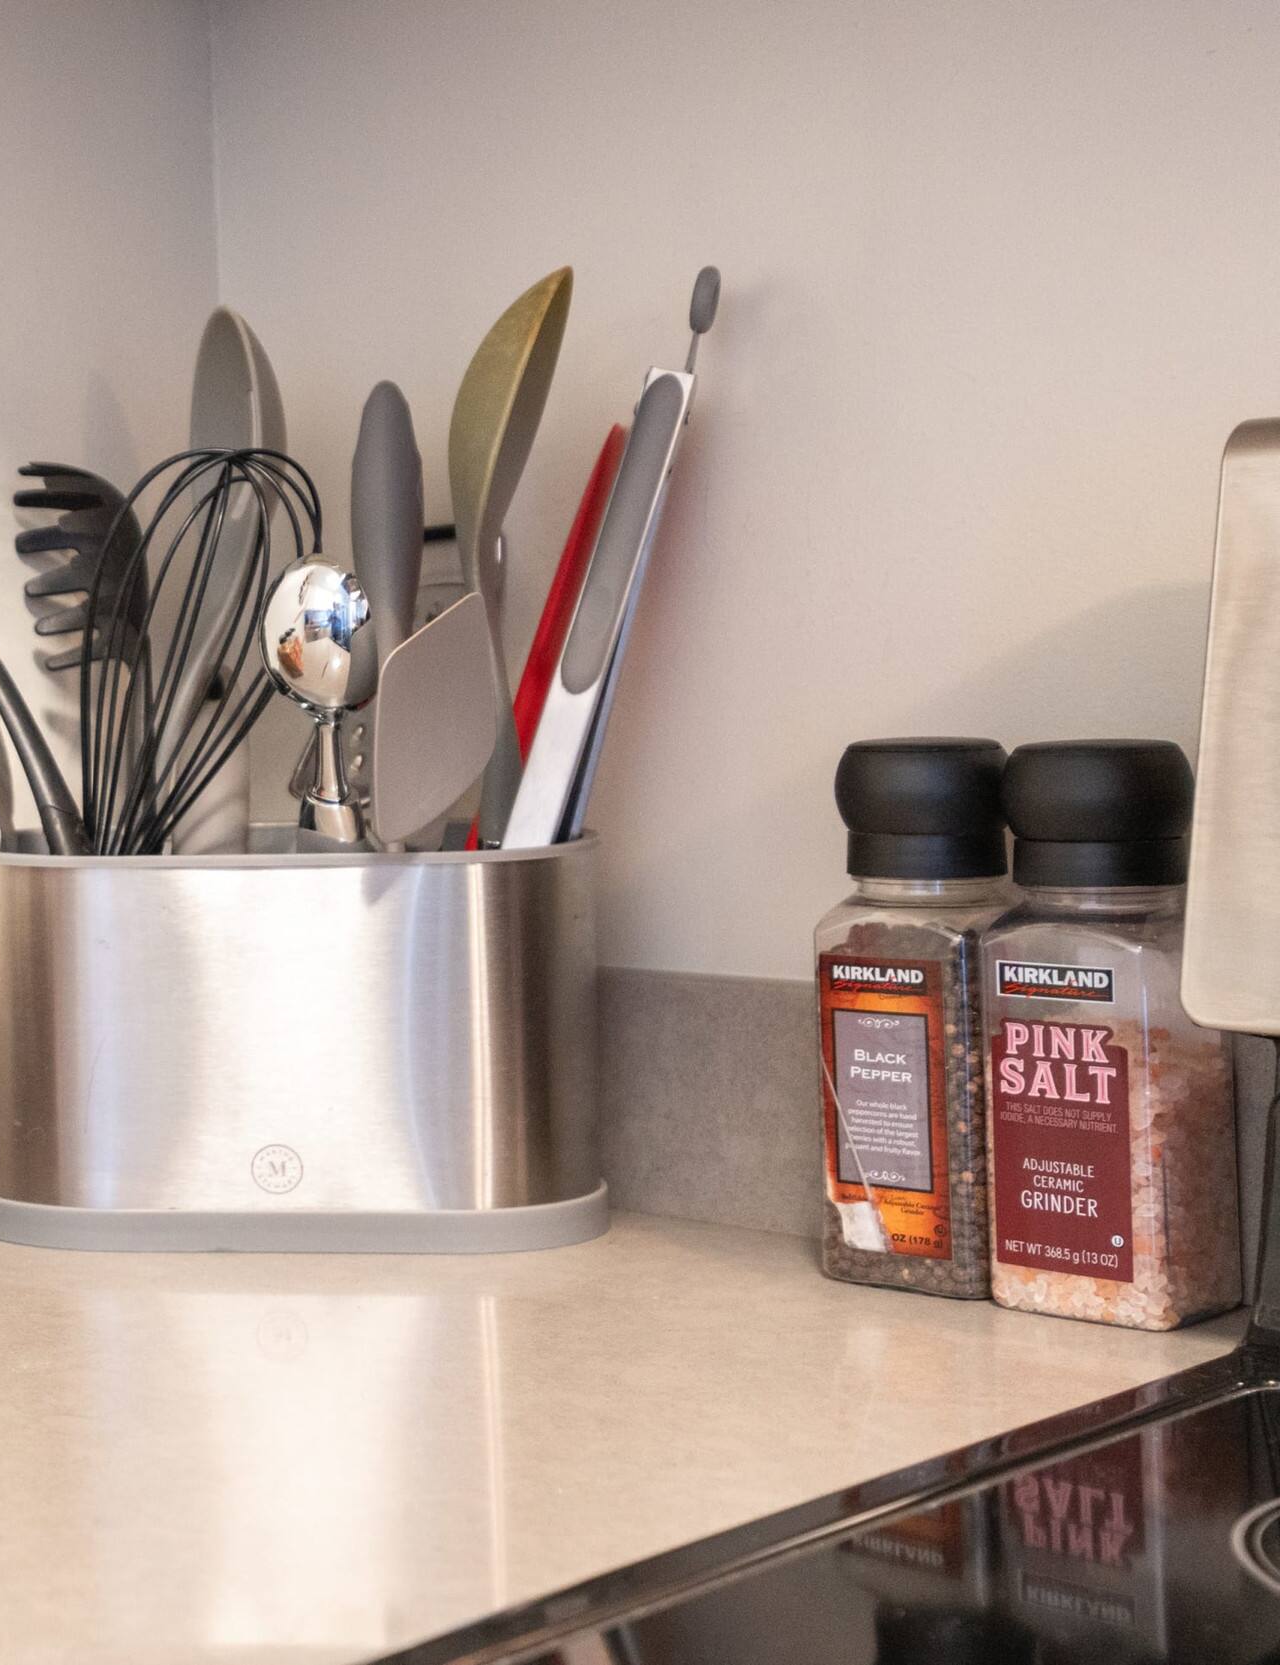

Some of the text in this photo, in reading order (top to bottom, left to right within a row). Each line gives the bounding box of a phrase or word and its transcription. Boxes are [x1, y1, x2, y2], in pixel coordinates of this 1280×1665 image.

[832, 965, 924, 984] KIRKLAND
[1004, 965, 1109, 988] KIRKLAND
[1005, 1022, 1110, 1063] PINK
[1000, 1057, 1117, 1104] SALT
[1000, 1111, 1119, 1134] IODIDE, A NECESSARY NUTRIENT.
[1006, 1101, 1112, 1122] THIS SALT DOES NOT SUPPLY
[1023, 1157, 1095, 1178] ADJUSTABLE
[1033, 1174, 1084, 1193] CERAMIC
[1021, 1190, 1098, 1218] GRINDER
[892, 1233, 906, 1242] OZ
[909, 1236, 931, 1246] (178
[1005, 1239, 1118, 1269] NET WT 368.5 g (13 OZ)
